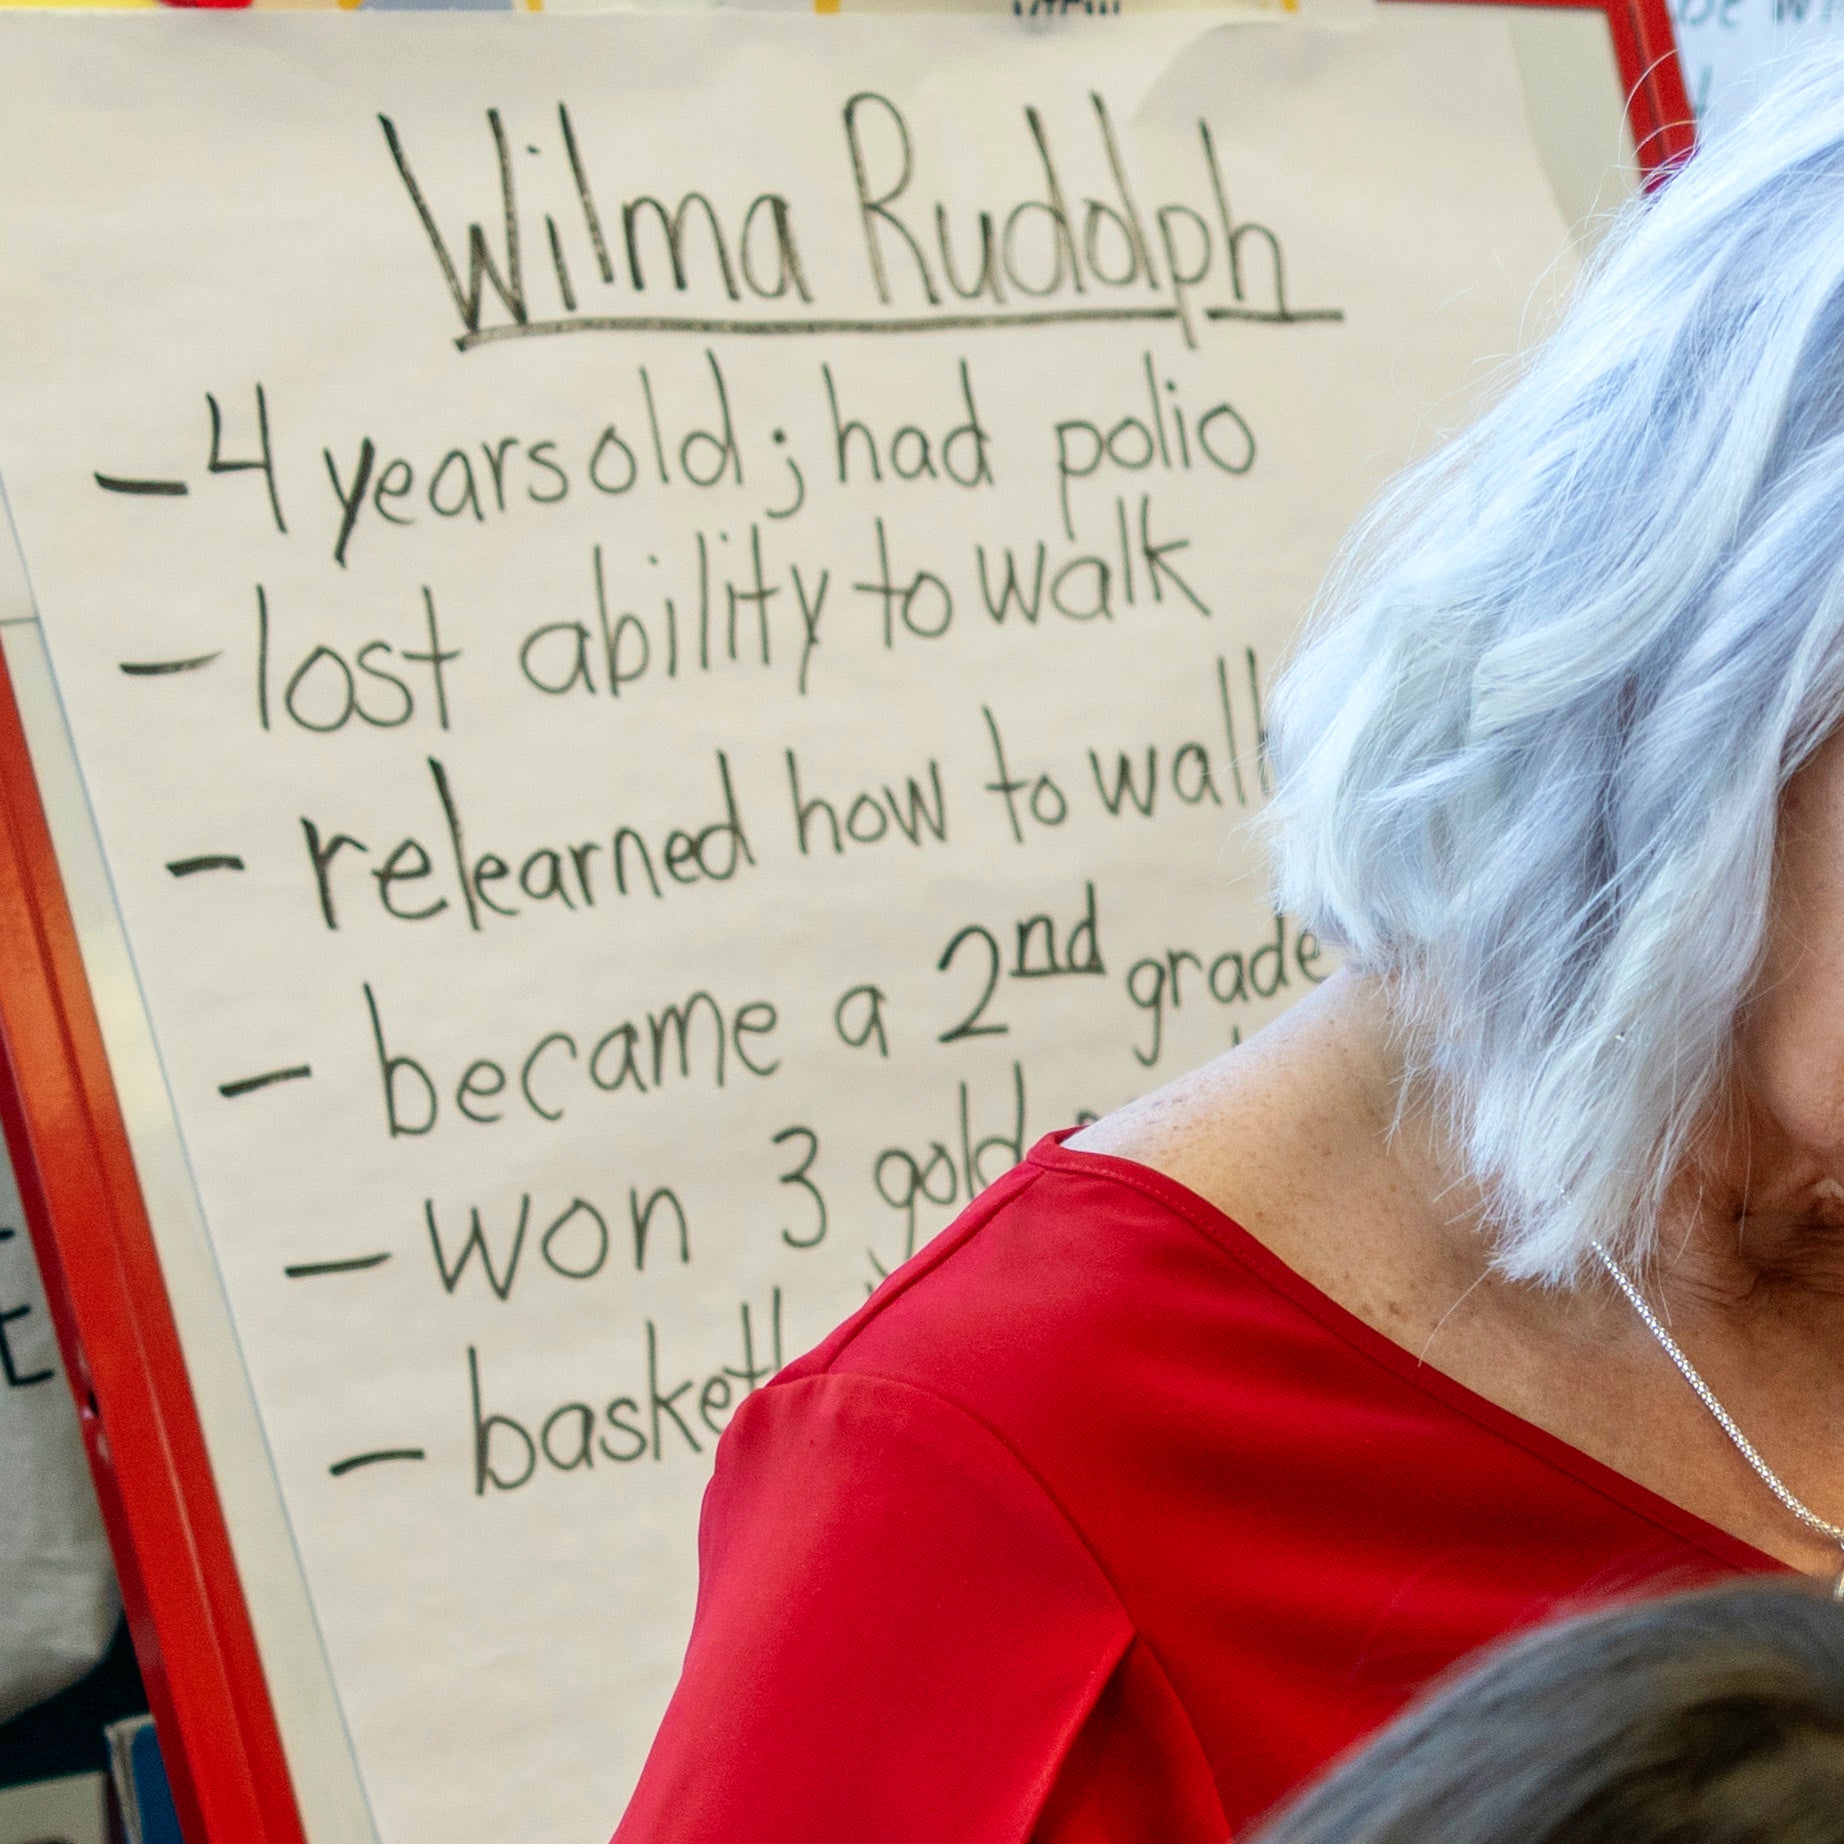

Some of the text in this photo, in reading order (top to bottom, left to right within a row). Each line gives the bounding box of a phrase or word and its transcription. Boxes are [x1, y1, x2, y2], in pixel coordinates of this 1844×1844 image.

[378, 91, 1290, 349] Wilma Rudolph
[822, 357, 994, 487] had
[1055, 351, 1256, 540] polio
[256, 493, 1213, 732] lost ability to walk
[300, 749, 755, 932] relearned
[787, 748, 947, 857] how
[983, 705, 1068, 843] to
[363, 881, 1328, 1139] became a 2nd grade
[424, 1186, 691, 1302] won
[772, 1125, 829, 1250] 3
[874, 1059, 1027, 1259] gold
[468, 1285, 795, 1497] basket
